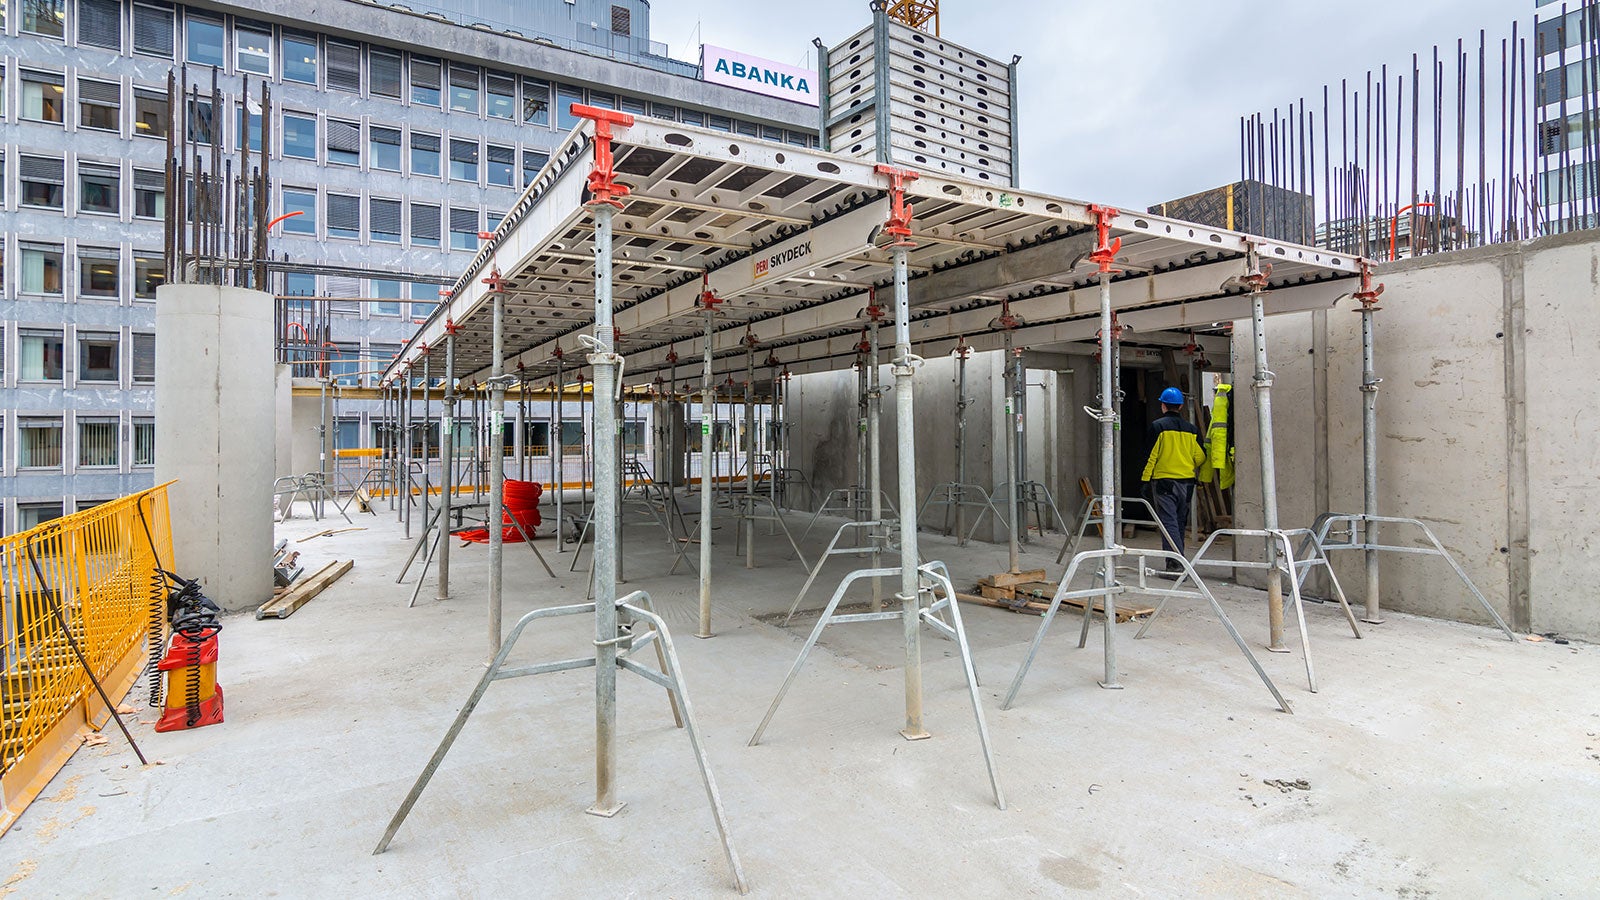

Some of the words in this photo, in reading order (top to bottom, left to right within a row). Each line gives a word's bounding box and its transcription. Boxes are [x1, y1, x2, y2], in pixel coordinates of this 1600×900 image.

[715, 58, 810, 94] ABANKA
[756, 259, 769, 274] PERI
[770, 241, 811, 268] SKYDECK
